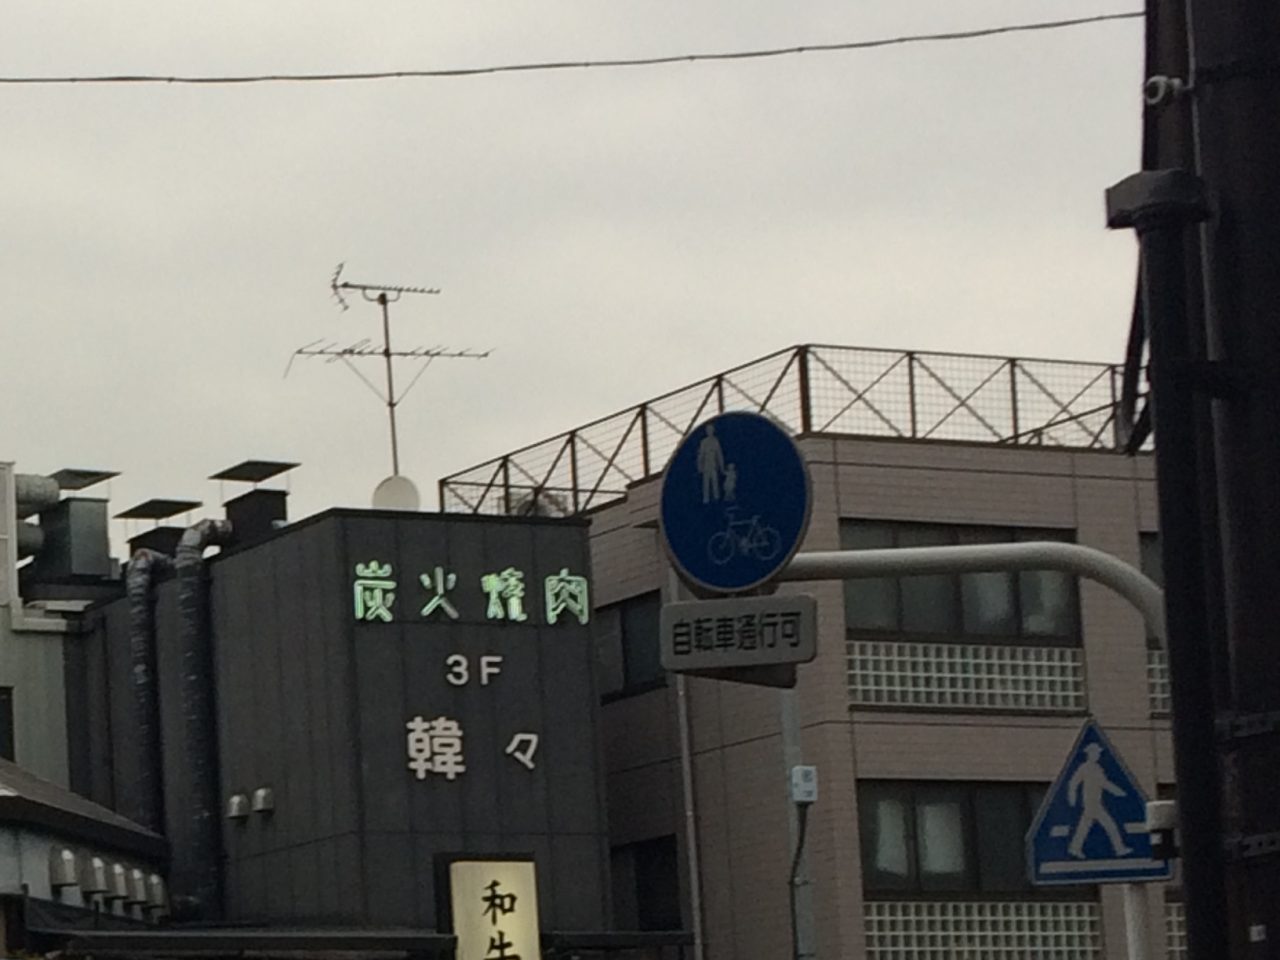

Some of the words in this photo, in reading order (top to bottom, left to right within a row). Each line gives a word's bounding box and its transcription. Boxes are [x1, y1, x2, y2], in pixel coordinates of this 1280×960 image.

[672, 611, 802, 656] 自転車通行可
[445, 653, 503, 686] 3F
[405, 716, 539, 780] 韓々
